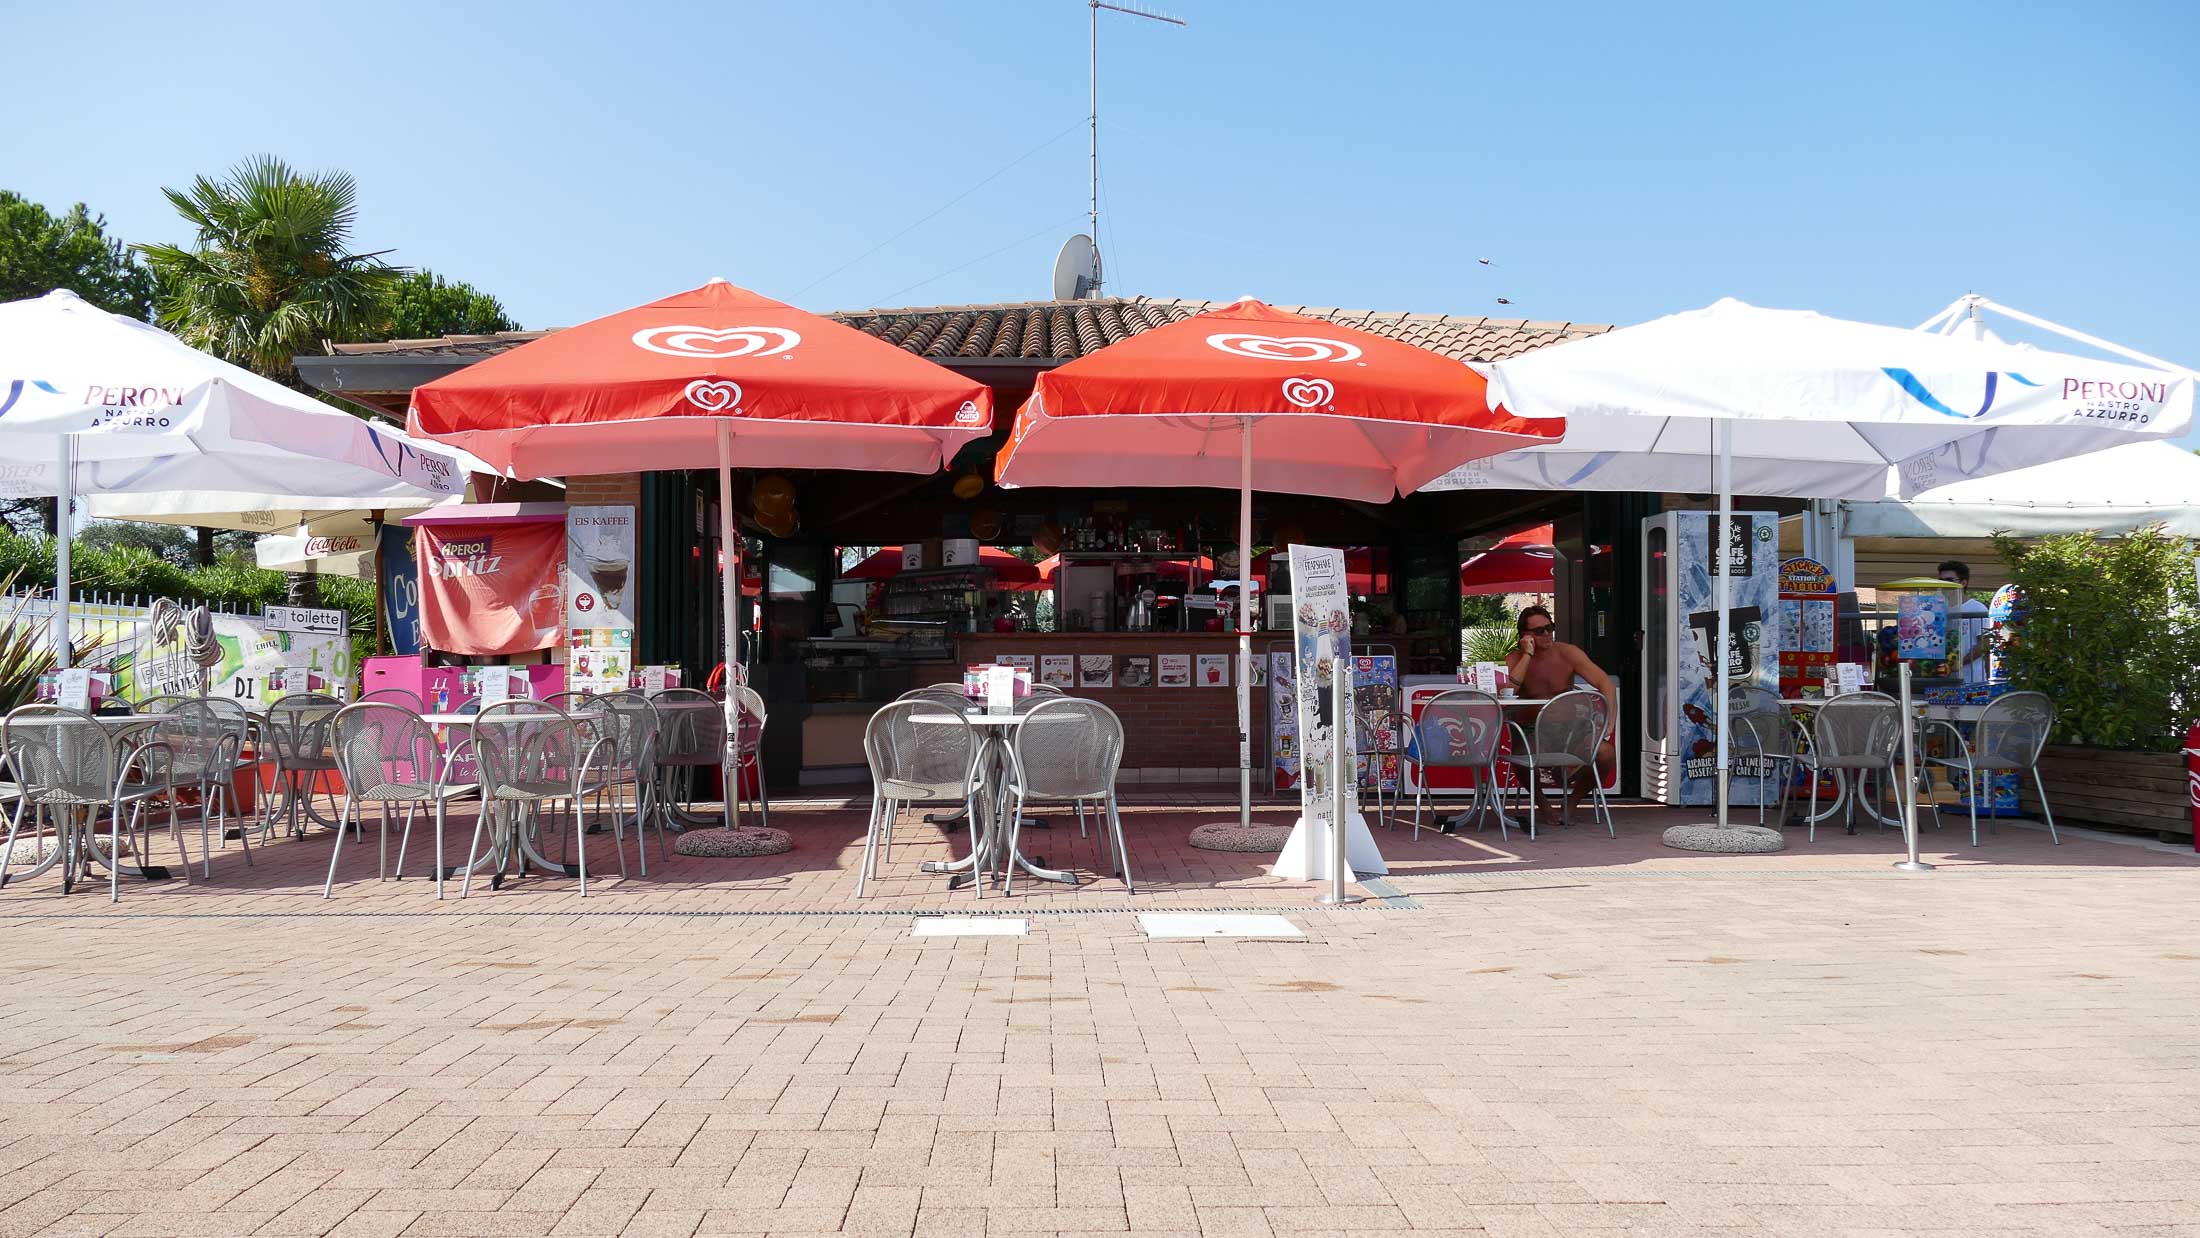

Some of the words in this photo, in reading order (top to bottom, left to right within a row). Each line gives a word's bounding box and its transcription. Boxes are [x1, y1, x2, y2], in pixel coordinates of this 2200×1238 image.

[83, 385, 184, 406] PERONI
[2062, 377, 2166, 403] PERONI
[2086, 400, 2140, 411] NASTRO
[2073, 408, 2150, 424] AZZURRO
[575, 517, 590, 526] EIS
[591, 516, 629, 526] KAFFEE
[441, 542, 487, 556] APEROL
[428, 555, 502, 580] Spritz
[1783, 560, 1824, 576] STICKER
[1778, 581, 1827, 592] TATTOO
[291, 610, 340, 625] toilette
[234, 676, 255, 700] DI
